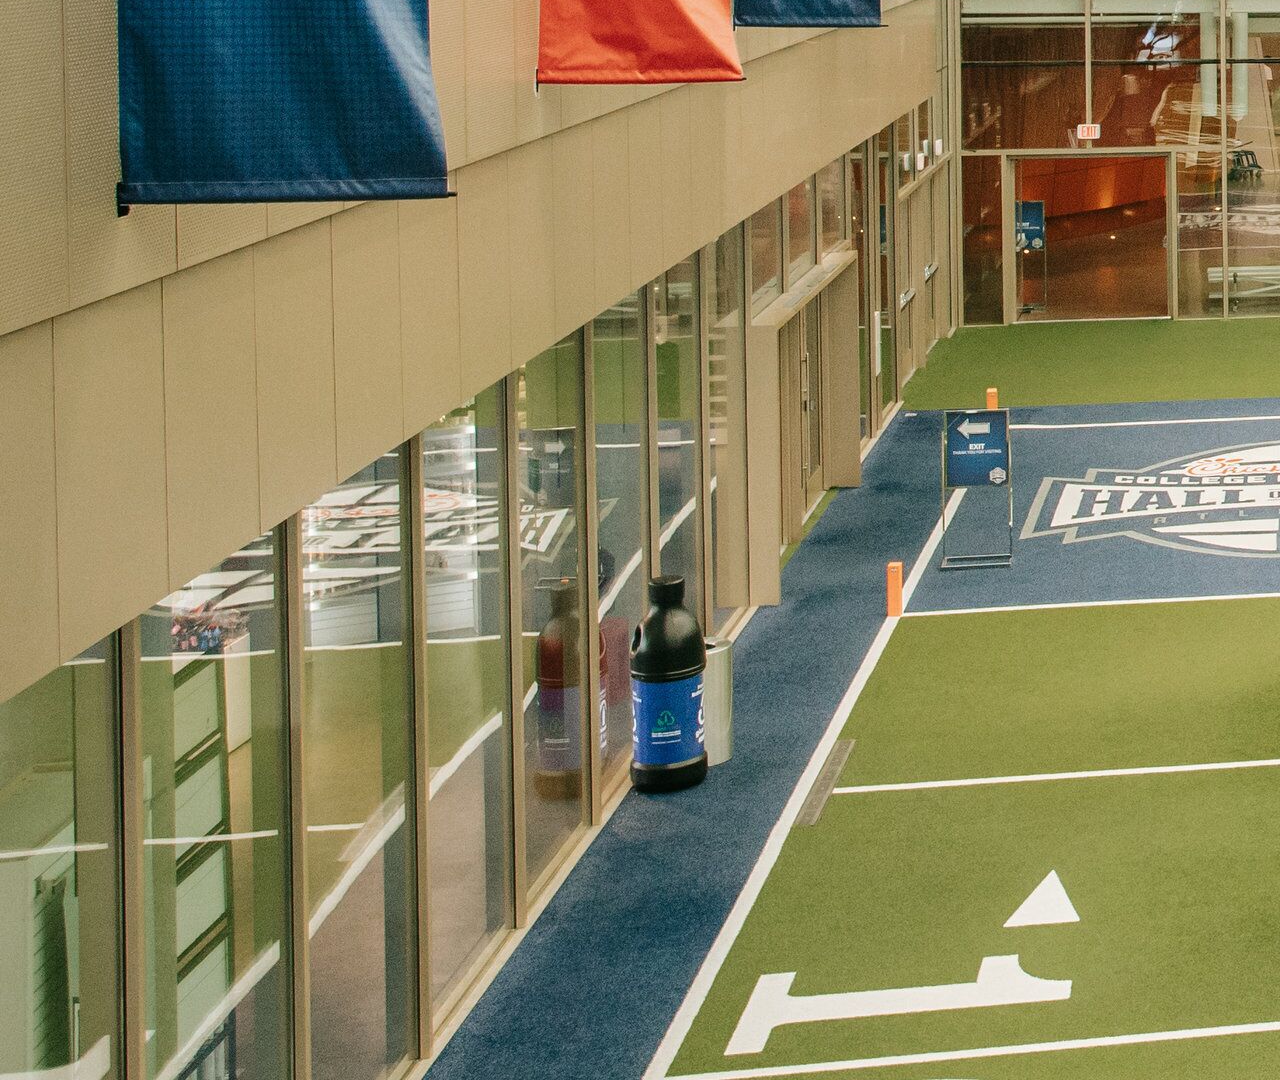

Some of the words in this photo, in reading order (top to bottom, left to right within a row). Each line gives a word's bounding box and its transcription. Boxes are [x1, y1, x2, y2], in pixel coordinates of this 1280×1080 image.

[1082, 126, 1097, 138] EXIT
[1114, 474, 1267, 485] COLLEGE
[1071, 489, 1256, 520] HALL
[724, 954, 1073, 1056] 1
